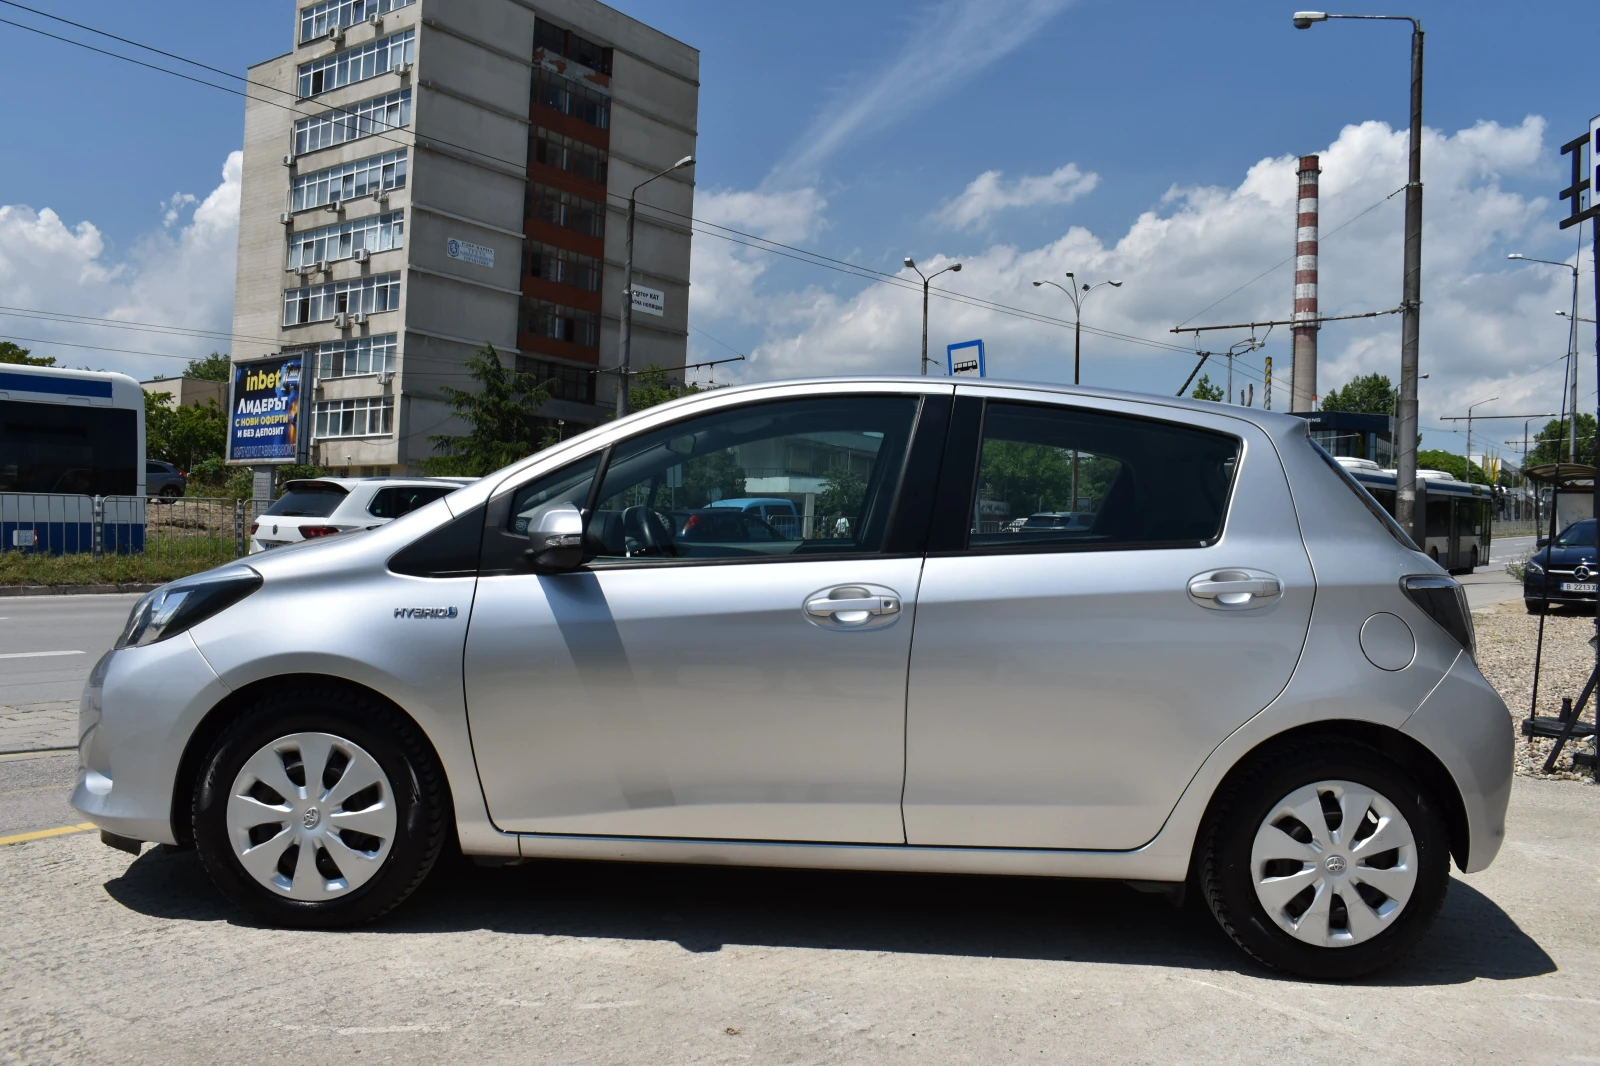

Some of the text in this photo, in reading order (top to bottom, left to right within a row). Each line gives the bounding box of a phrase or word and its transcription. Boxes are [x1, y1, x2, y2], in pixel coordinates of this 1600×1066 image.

[246, 369, 281, 391] inbet
[235, 414, 288, 427] С НОВИ ОФЕРТИ
[237, 427, 284, 438] И БЕЗ ДЕПОЗИТ
[393, 606, 448, 619] HYBRID
